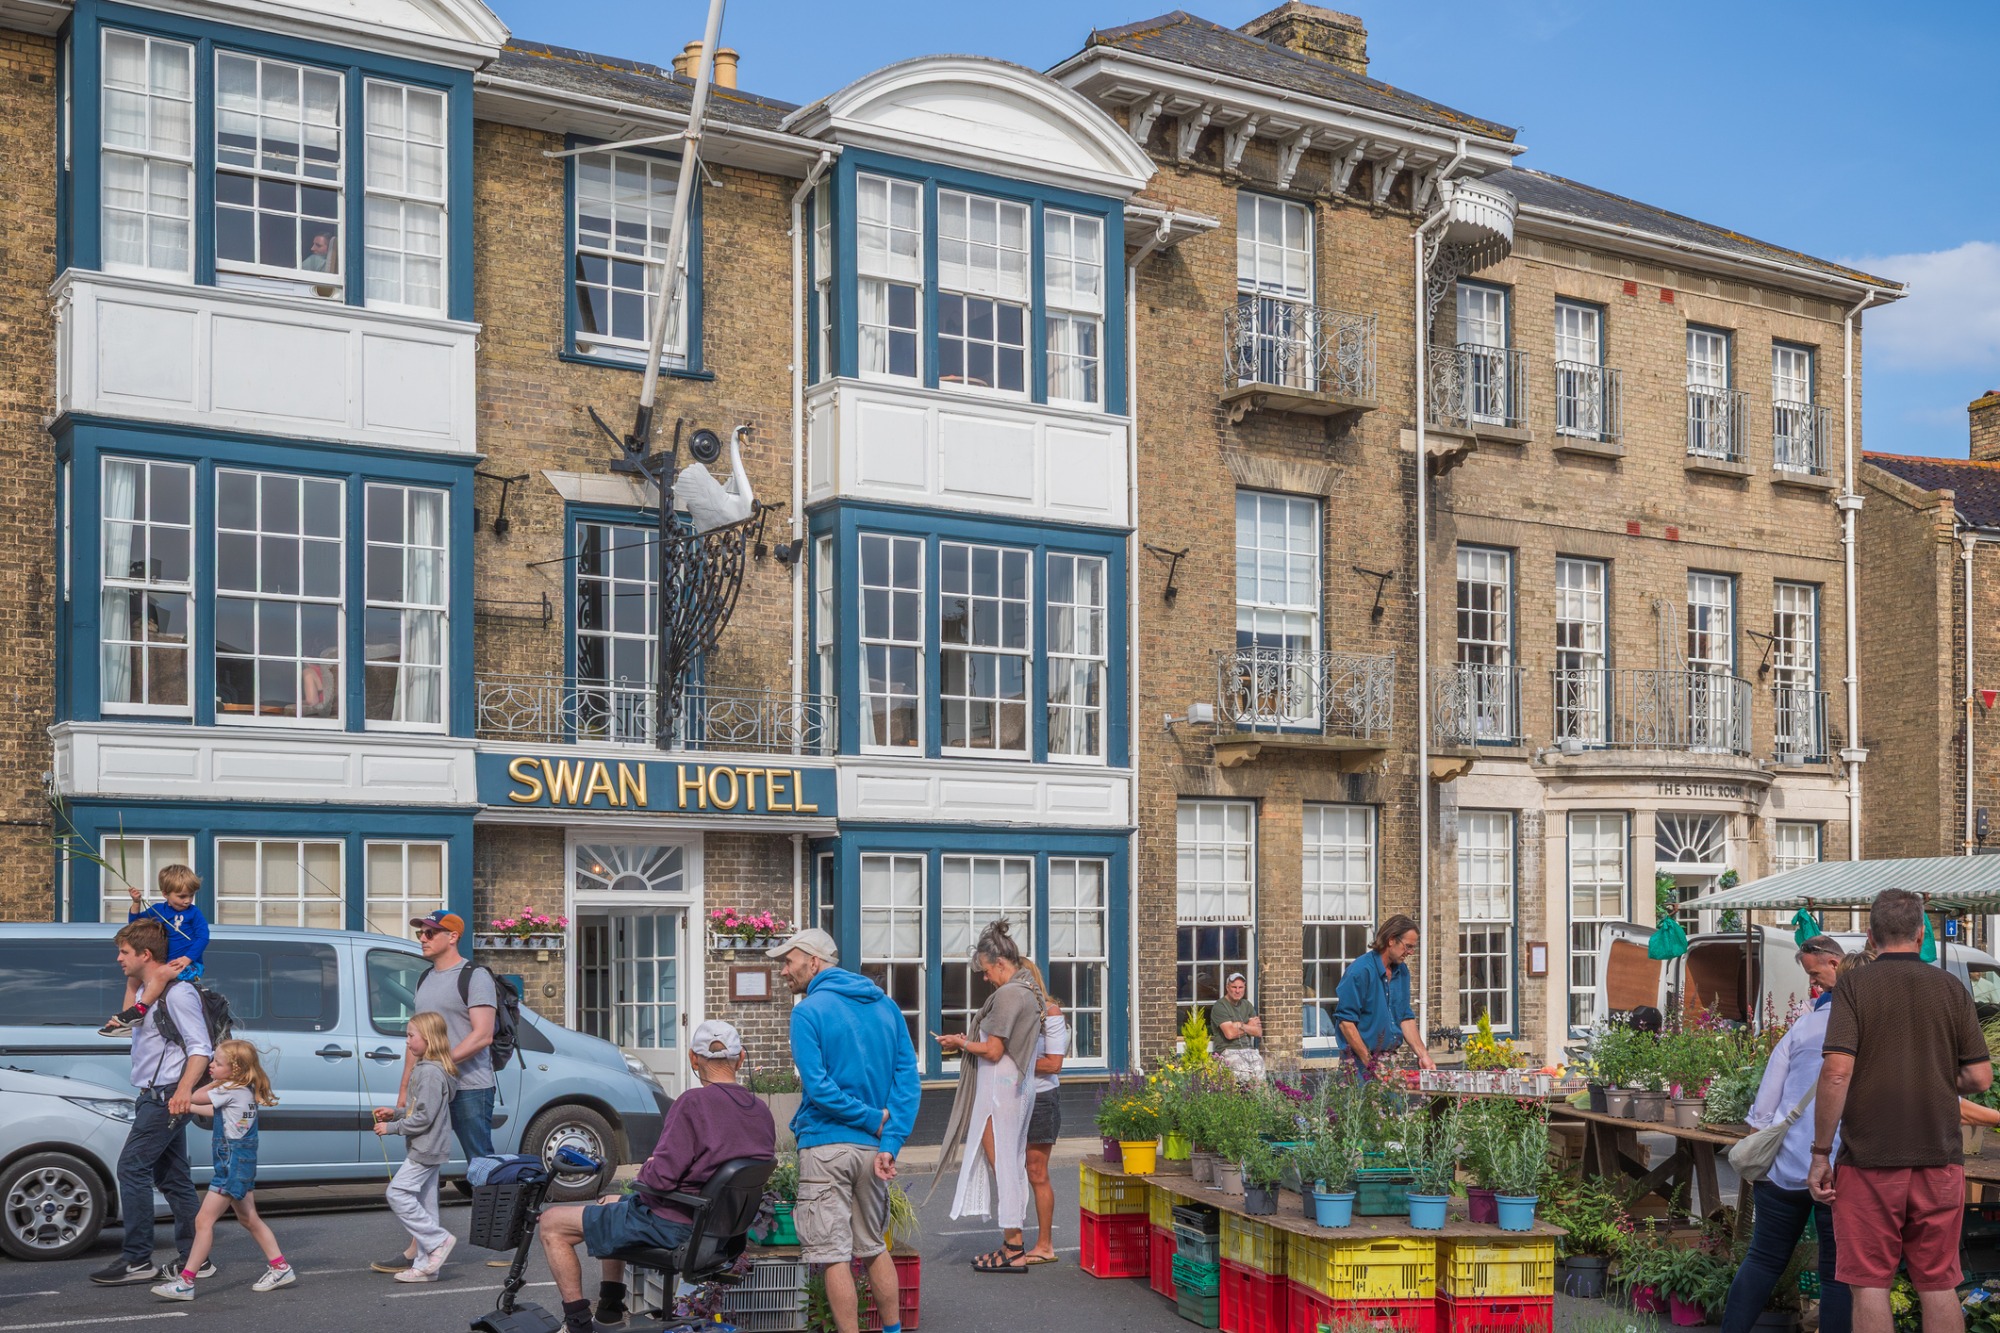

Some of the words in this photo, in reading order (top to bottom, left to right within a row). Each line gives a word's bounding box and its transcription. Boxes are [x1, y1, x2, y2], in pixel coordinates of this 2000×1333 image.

[508, 757, 648, 807] SWAN
[677, 764, 819, 813] HOTEL
[1657, 784, 1681, 795] THE
[1686, 785, 1715, 796] STILL
[1717, 786, 1742, 799] ROOM
